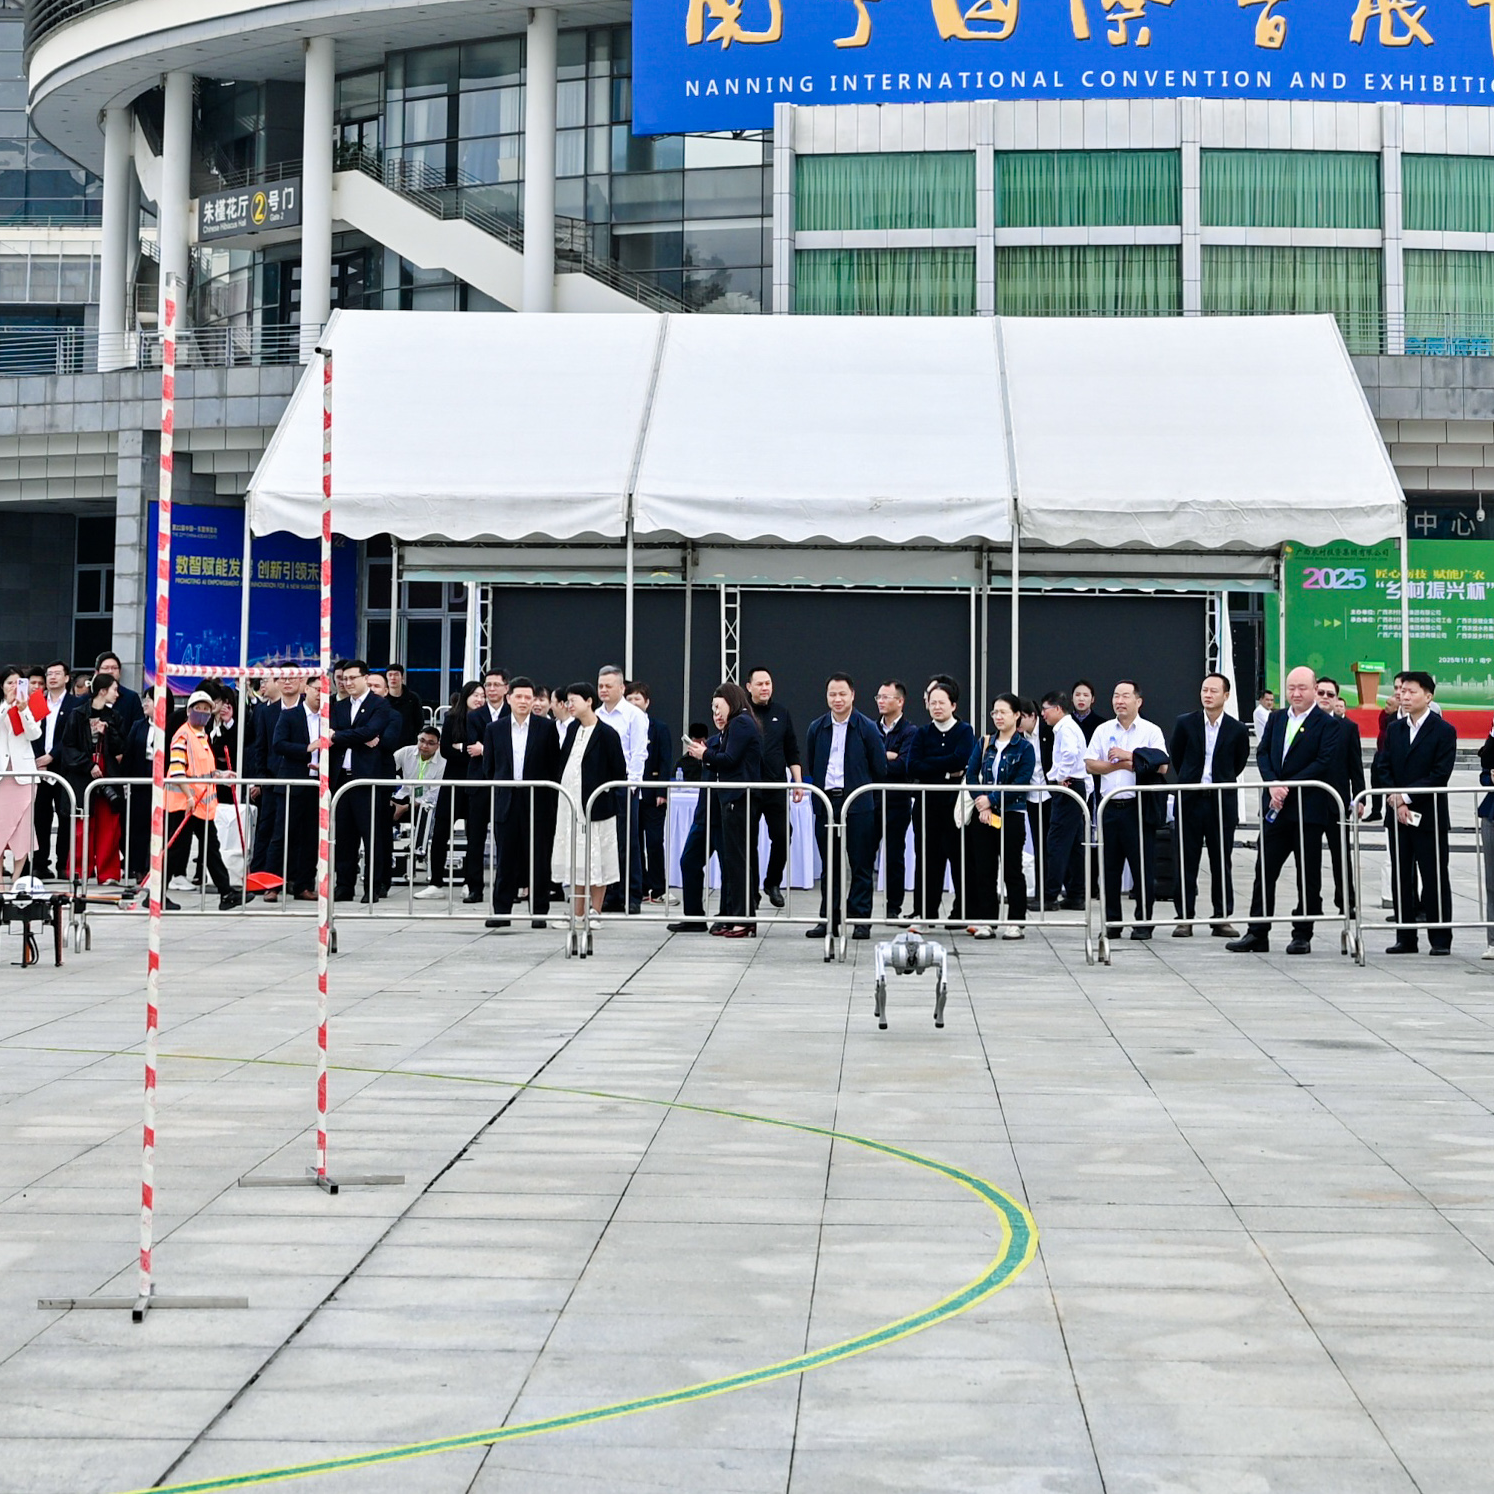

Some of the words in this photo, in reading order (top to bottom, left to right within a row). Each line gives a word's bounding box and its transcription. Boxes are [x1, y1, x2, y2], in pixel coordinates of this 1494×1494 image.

[686, 75, 814, 97] NANNING
[829, 70, 1064, 93] INTERNATIONAL
[1081, 70, 1272, 89] CONVENTION
[1289, 71, 1347, 90] AND
[203, 195, 249, 224] 朱槿花厅
[268, 187, 294, 211] 号门
[269, 213, 281, 222] Gate
[1302, 567, 1367, 590] 2025
